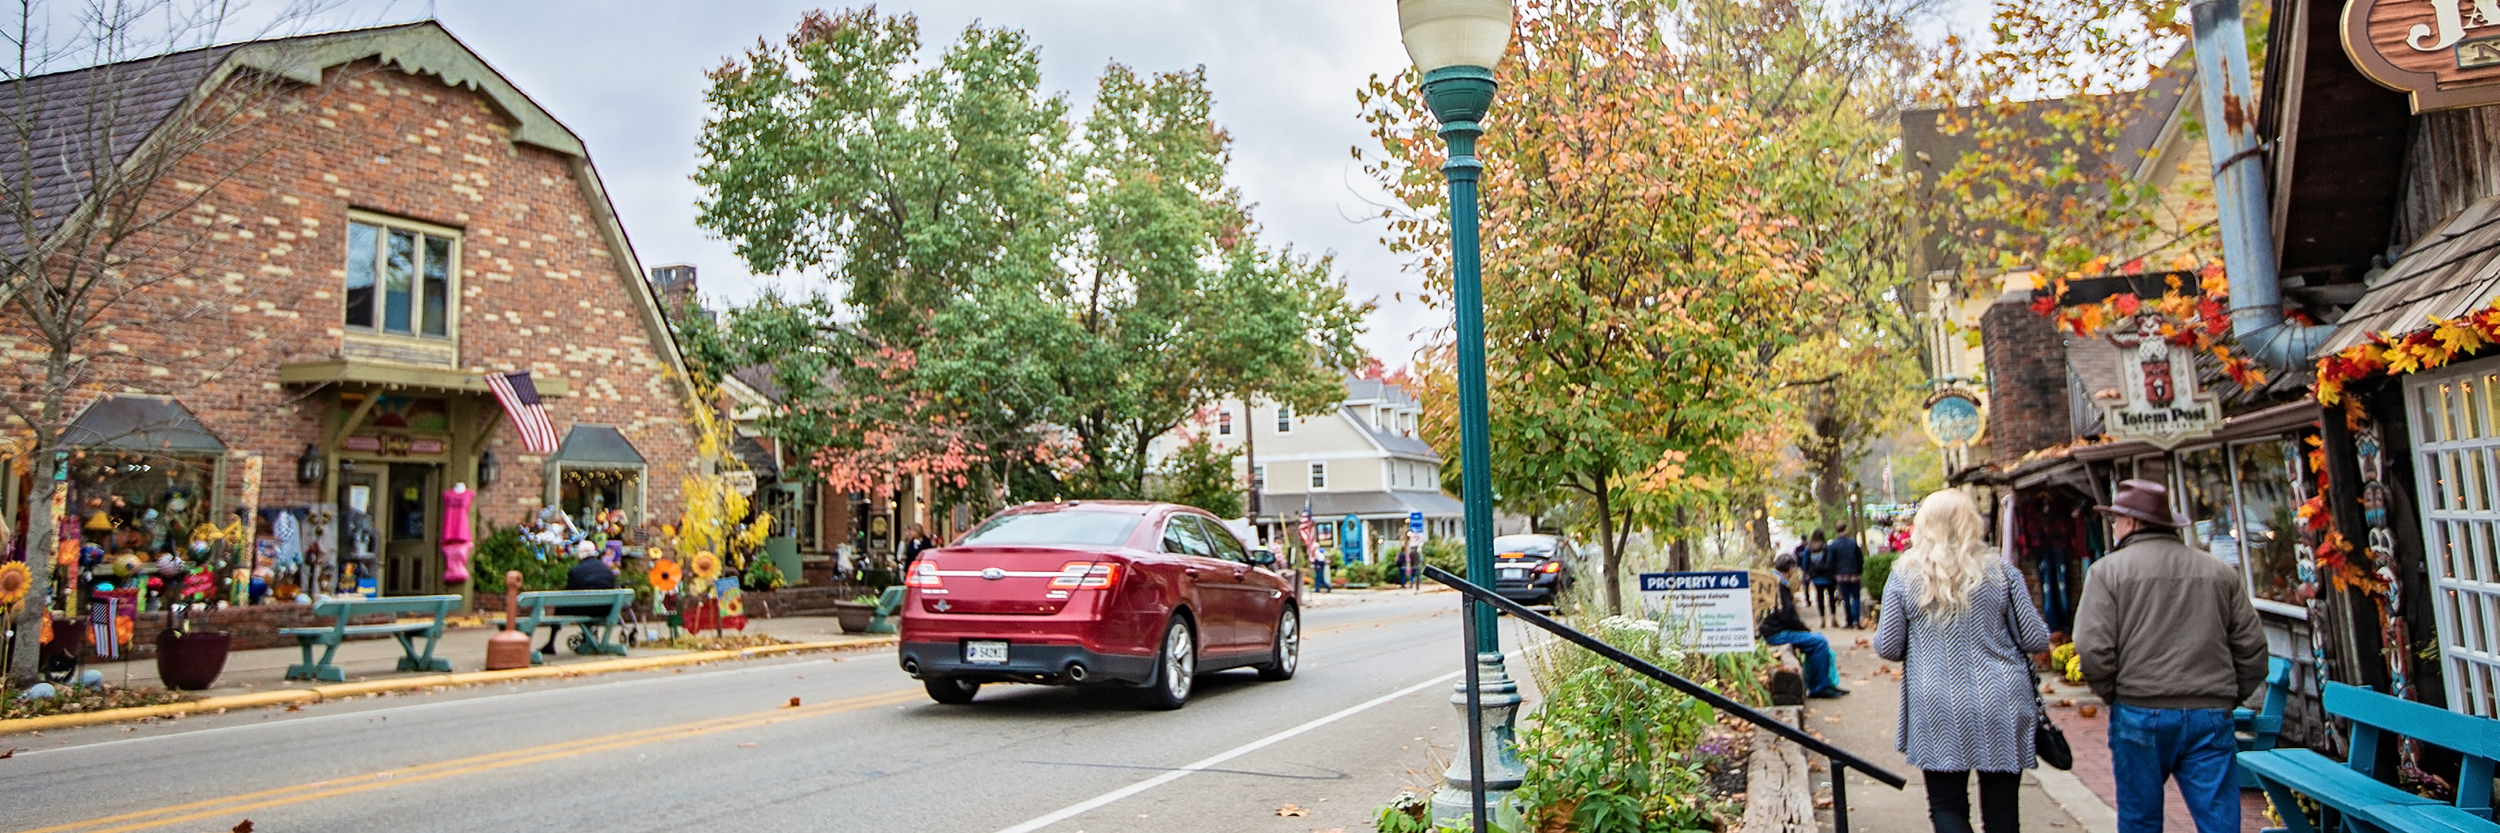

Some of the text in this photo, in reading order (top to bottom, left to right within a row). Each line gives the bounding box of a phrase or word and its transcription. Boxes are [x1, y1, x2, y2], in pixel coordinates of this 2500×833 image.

[2119, 406, 2206, 425] Totem Post
[1647, 575, 1740, 590] PROPERTY #6
